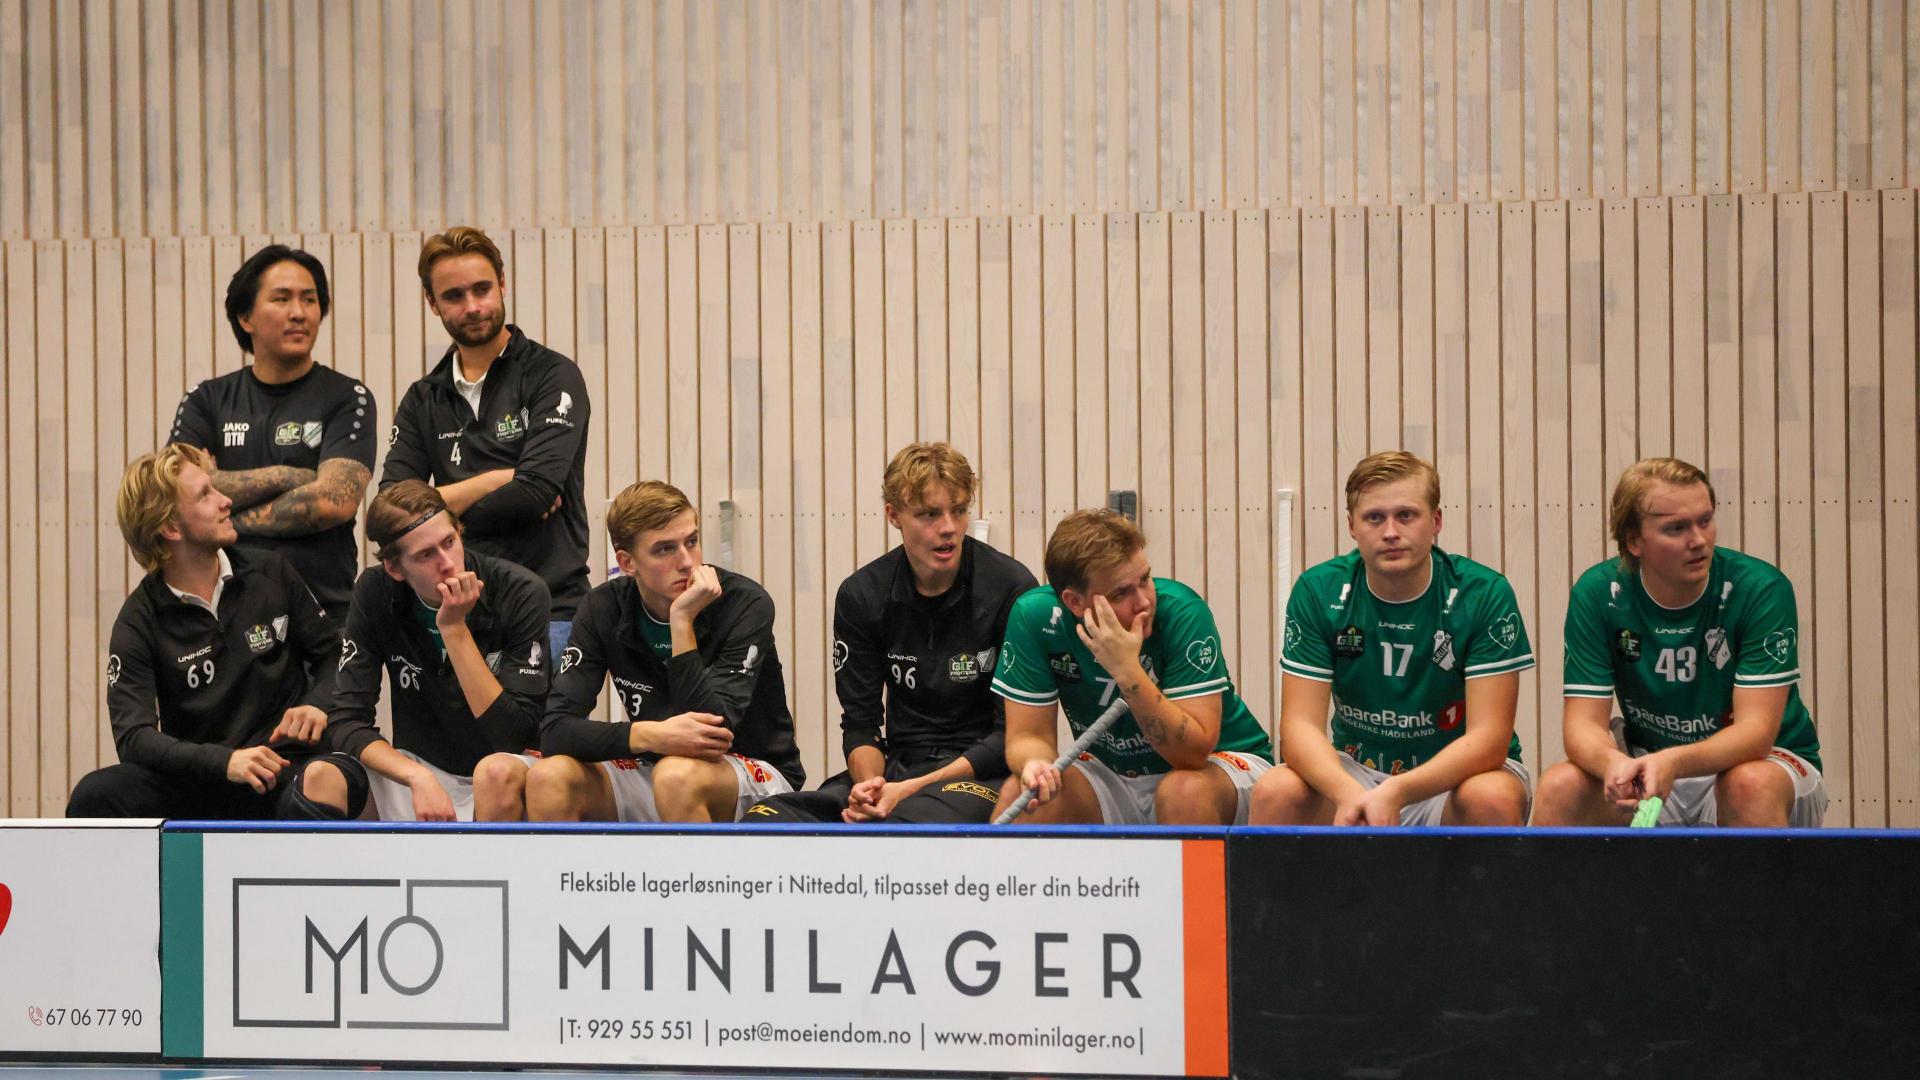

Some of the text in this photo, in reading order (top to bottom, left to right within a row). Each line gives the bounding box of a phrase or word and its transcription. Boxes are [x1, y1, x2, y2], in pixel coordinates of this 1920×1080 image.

[222, 421, 250, 432] JAKO
[450, 441, 462, 466] 4
[1378, 621, 1416, 630] UNIHOC
[177, 645, 213, 664] UNIHOC
[887, 652, 918, 662] UNIHOC
[1379, 641, 1414, 677] 17
[1654, 646, 1697, 682] 43
[187, 658, 216, 689] 69
[891, 663, 917, 690] 96
[1334, 694, 1433, 728] SpareBank
[1381, 728, 1436, 739] HADELAND
[560, 871, 1140, 902] Fleksible lagerløsninger i Nittedal, tilpasset deg eller din bedrift
[558, 923, 1142, 999] MINILAGER
[46, 1008, 142, 1027] 67 06 77 90
[587, 1019, 624, 1039] 929
[630, 1020, 654, 1040] 55
[660, 1020, 692, 1040] 551
[718, 1022, 911, 1047] post@moeiendom.no
